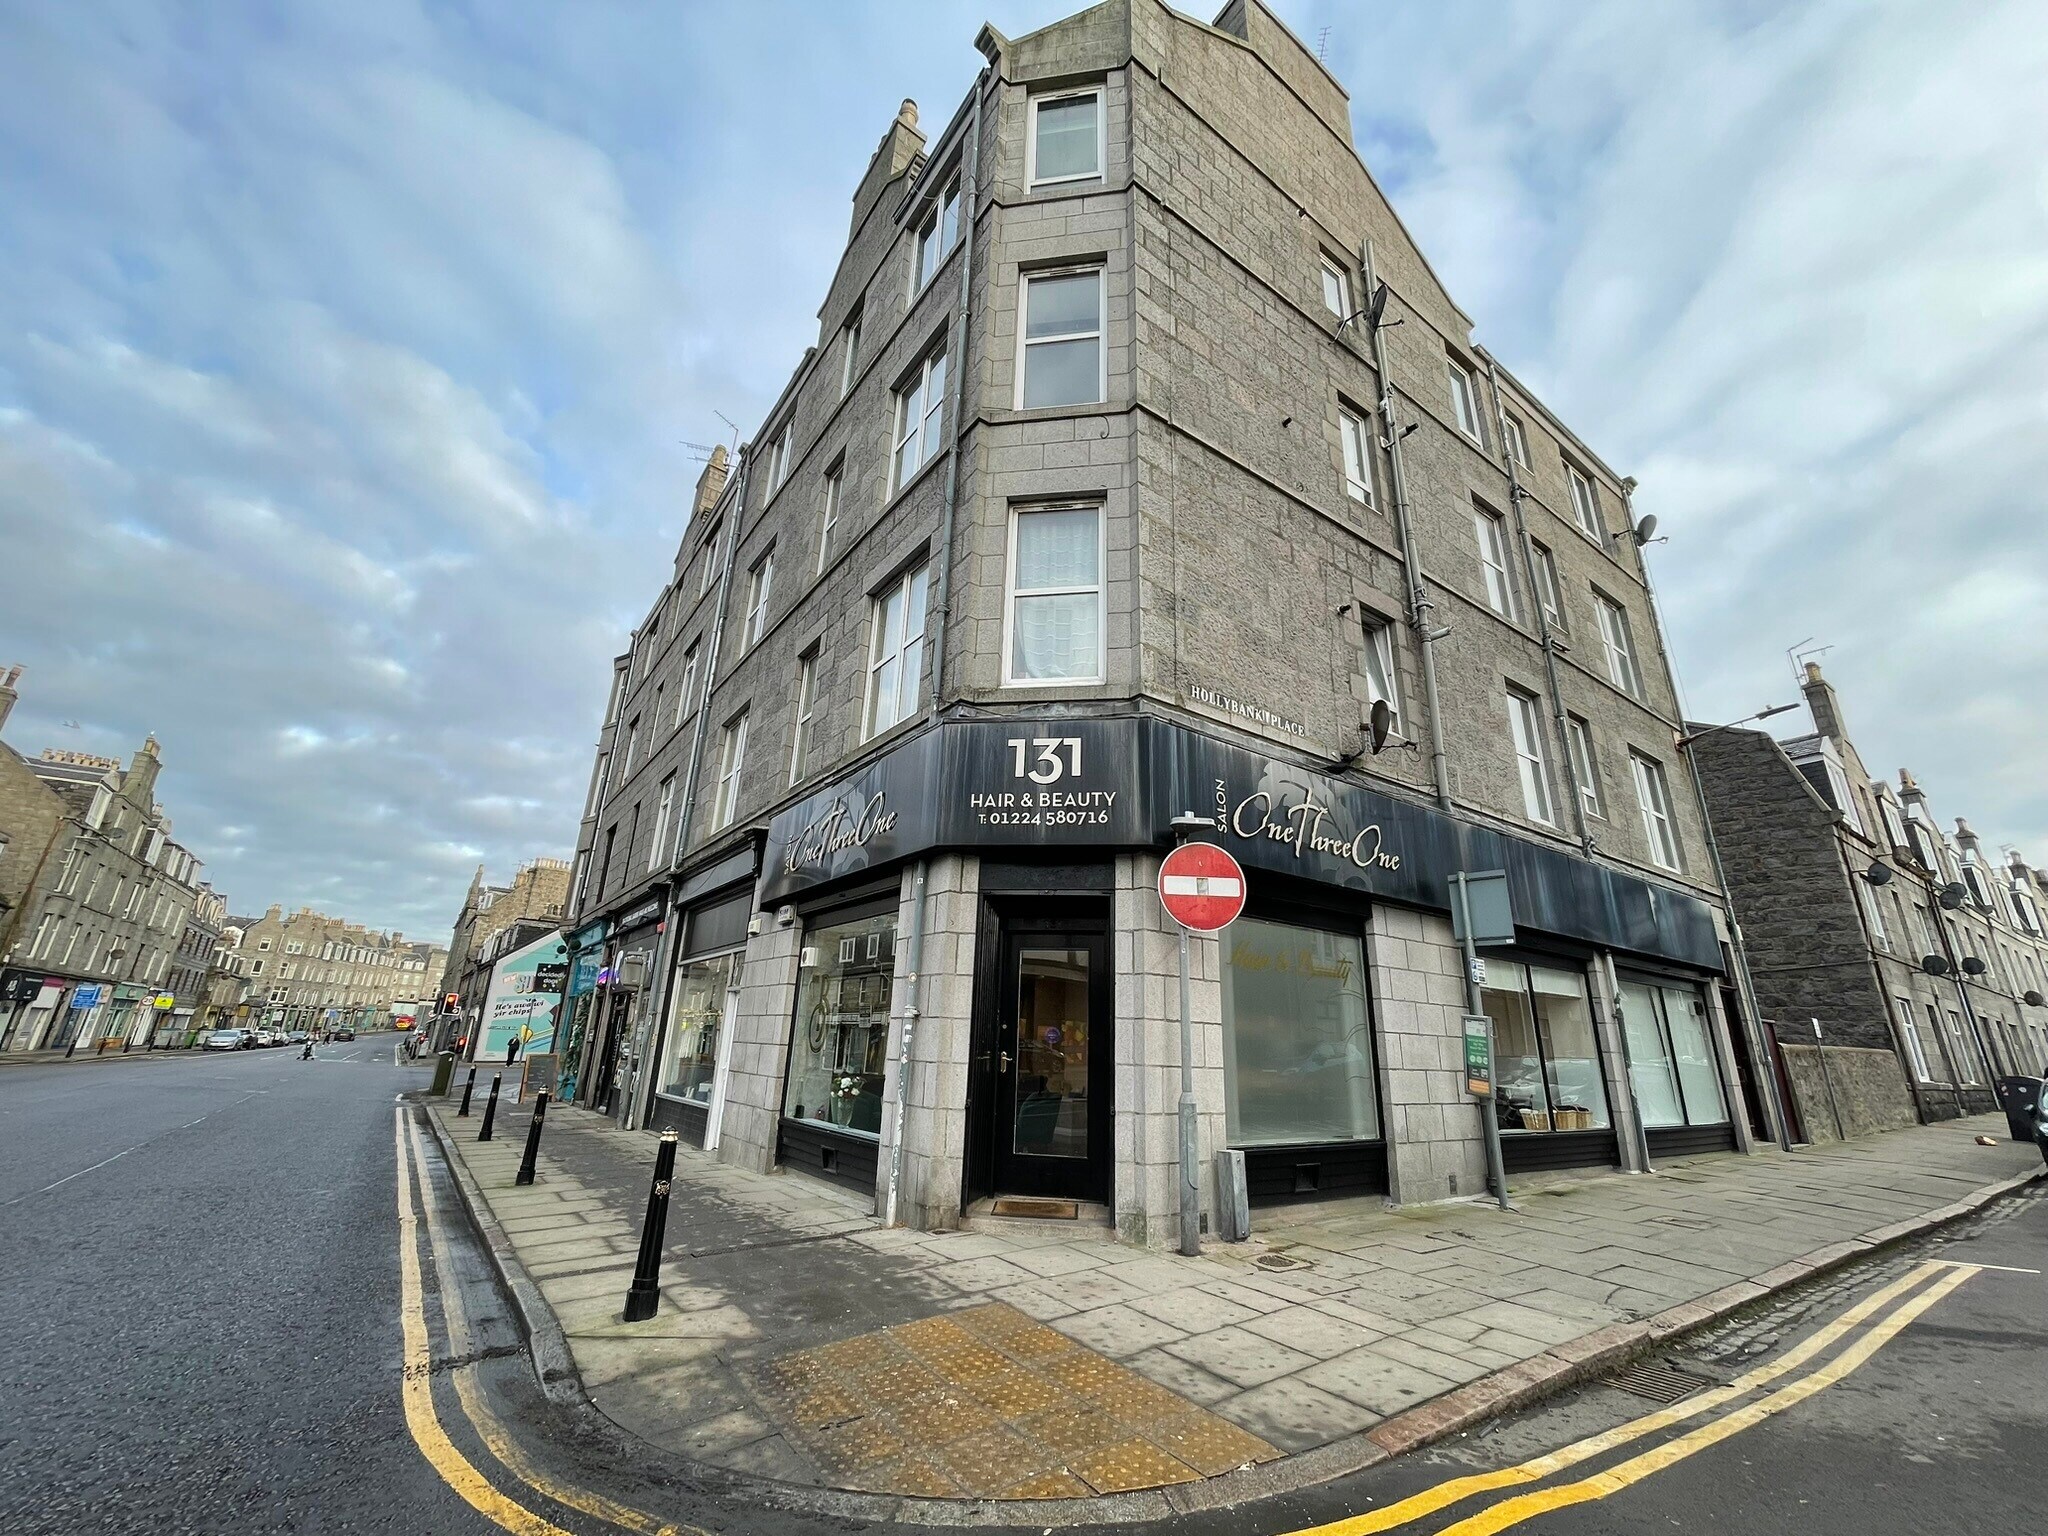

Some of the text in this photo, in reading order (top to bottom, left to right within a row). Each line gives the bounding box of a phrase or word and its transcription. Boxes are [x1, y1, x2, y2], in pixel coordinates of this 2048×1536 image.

[1191, 685, 1305, 737] HOLLYBANK PLACE
[1007, 737, 1082, 785] 131
[970, 790, 1117, 808] HAIR & BEAUTY
[990, 812, 1041, 826] 01224
[1045, 810, 1109, 826] 580716
[1215, 778, 1229, 834] SALON
